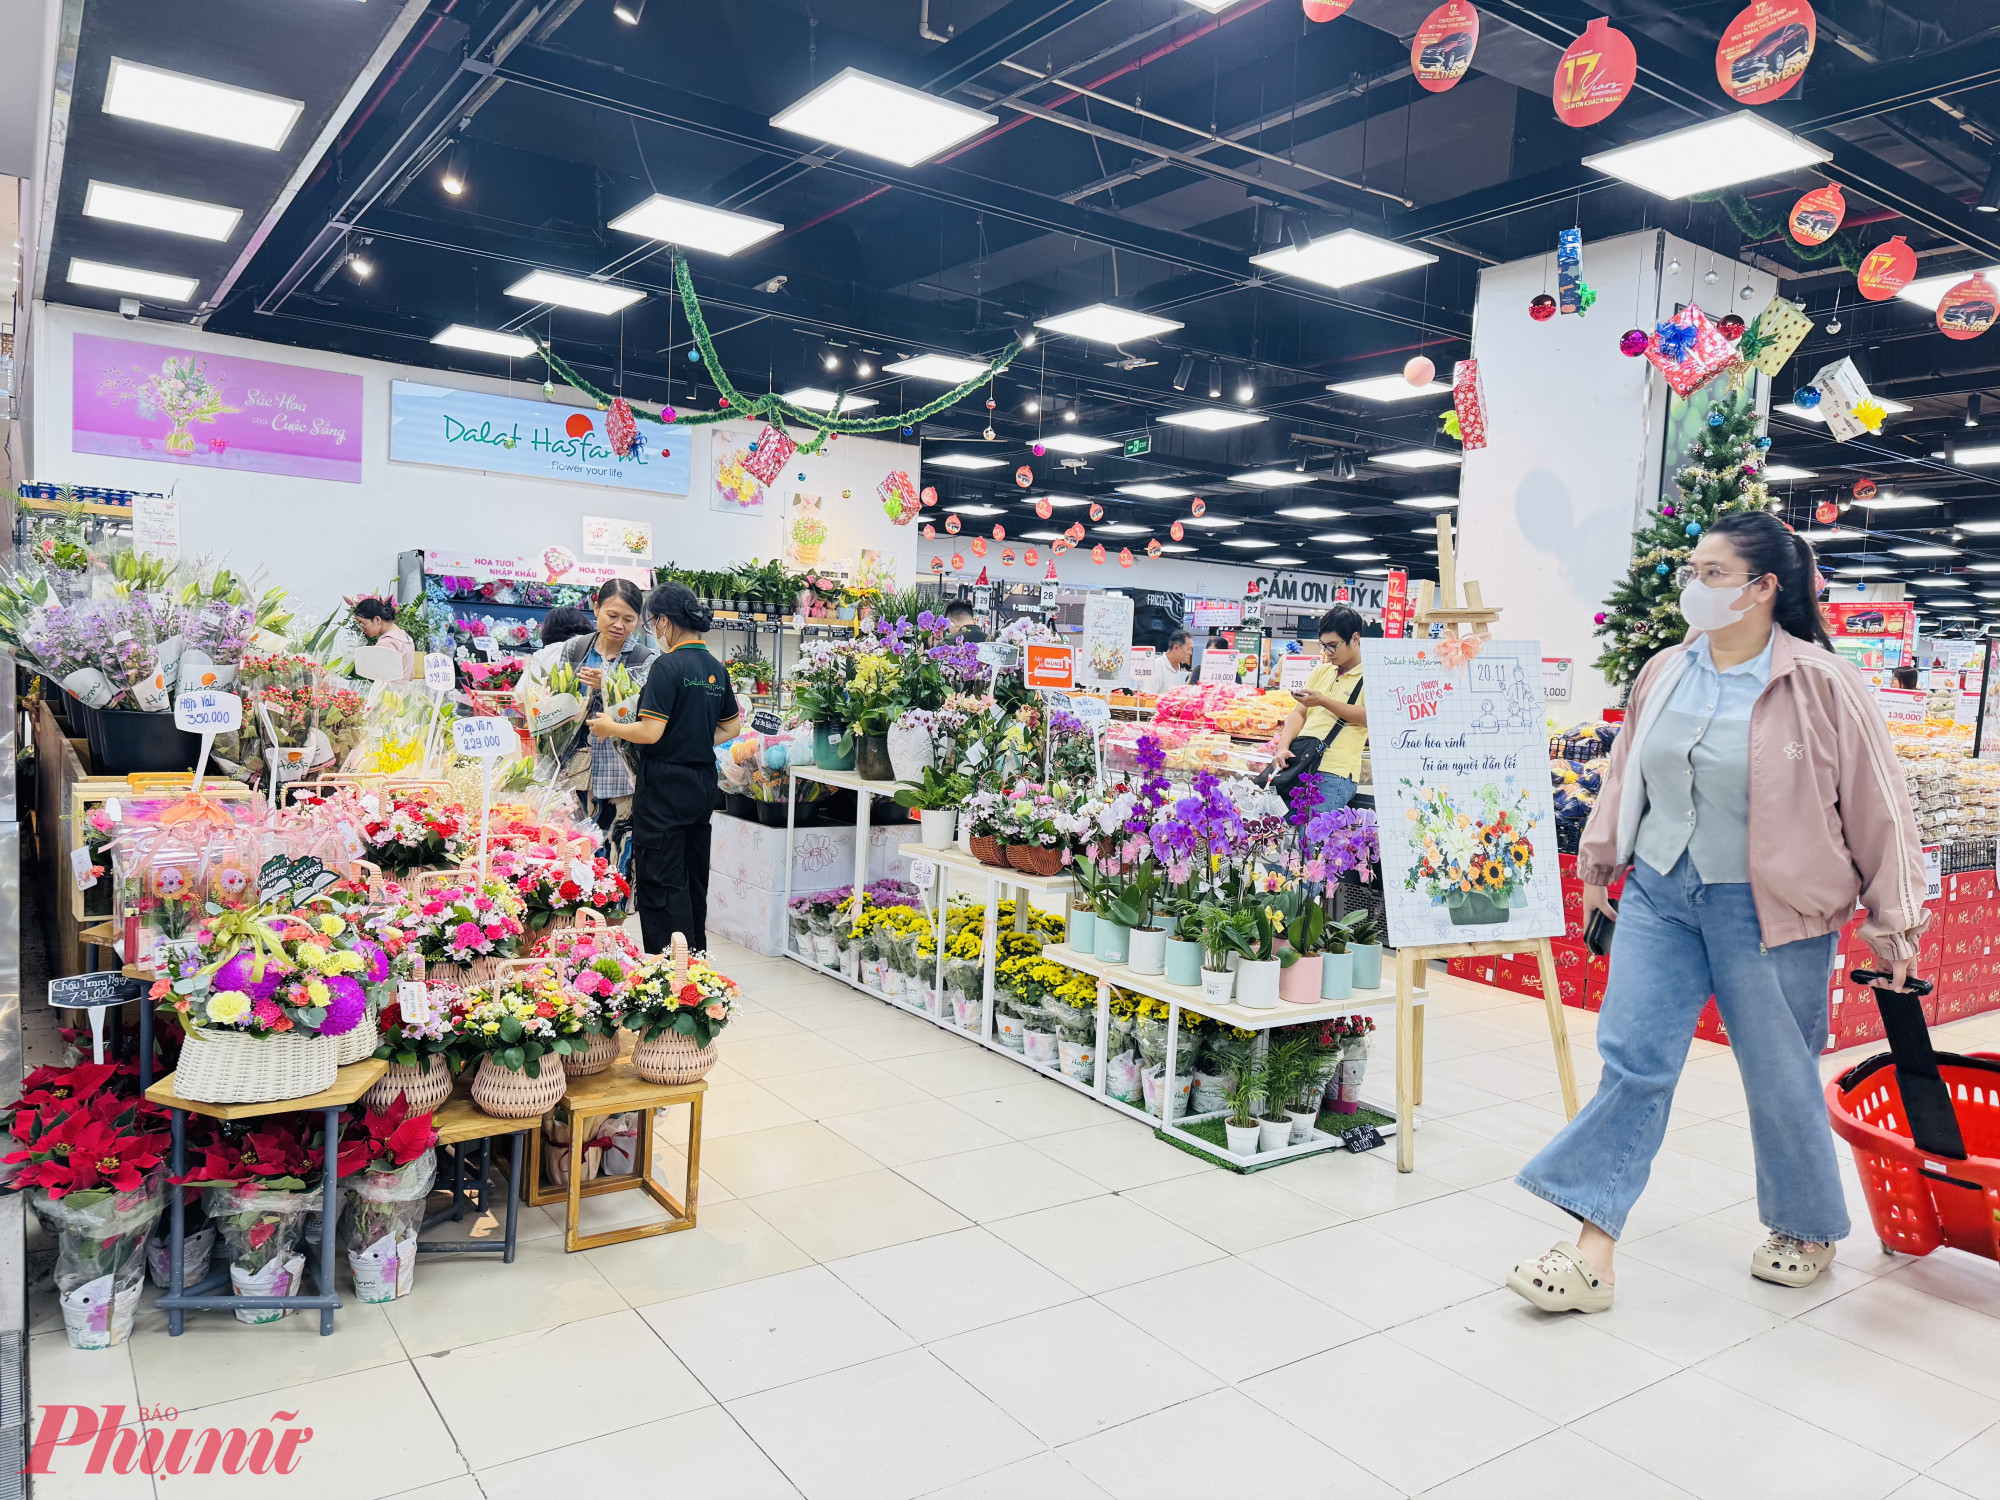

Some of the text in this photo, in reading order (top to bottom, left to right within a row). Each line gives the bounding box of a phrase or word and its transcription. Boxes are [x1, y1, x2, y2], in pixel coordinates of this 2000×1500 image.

[1561, 52, 1602, 104] 17
[1863, 255, 1896, 283] 17
[245, 388, 307, 412] Sắc Hoa
[272, 413, 307, 435] Cuộc
[309, 417, 346, 446] Sống
[443, 414, 522, 450] Dalat
[551, 461, 623, 478] Flower your life
[474, 558, 514, 567] HOA TƯƠI
[489, 568, 537, 578] NHẬP KHẨU
[1256, 571, 1297, 600] CẢM
[1302, 582, 1327, 603] ƠN
[1043, 592, 1054, 600] 28
[1389, 601, 1402, 610] CẢM
[1384, 656, 1443, 668] Dalat Hasfarm
[1134, 669, 1152, 677] 59,000
[1210, 673, 1234, 681] 119,000
[1478, 664, 1506, 682] 20.11
[180, 698, 197, 712] Hộp
[1408, 700, 1438, 721] DAY
[185, 711, 230, 725] 350.000
[1888, 711, 1922, 722] 139,000
[1444, 733, 1466, 748] xinh
[1420, 755, 1434, 771] Tri
[1436, 760, 1449, 771] ân
[1503, 753, 1517, 769] lối
[265, 863, 280, 875] HAPPY
[289, 865, 307, 878] HAPPY
[268, 880, 277, 888] DAY
[52, 980, 80, 992] Chậu
[81, 977, 107, 989] Trạng
[67, 986, 116, 1003] 79.000
